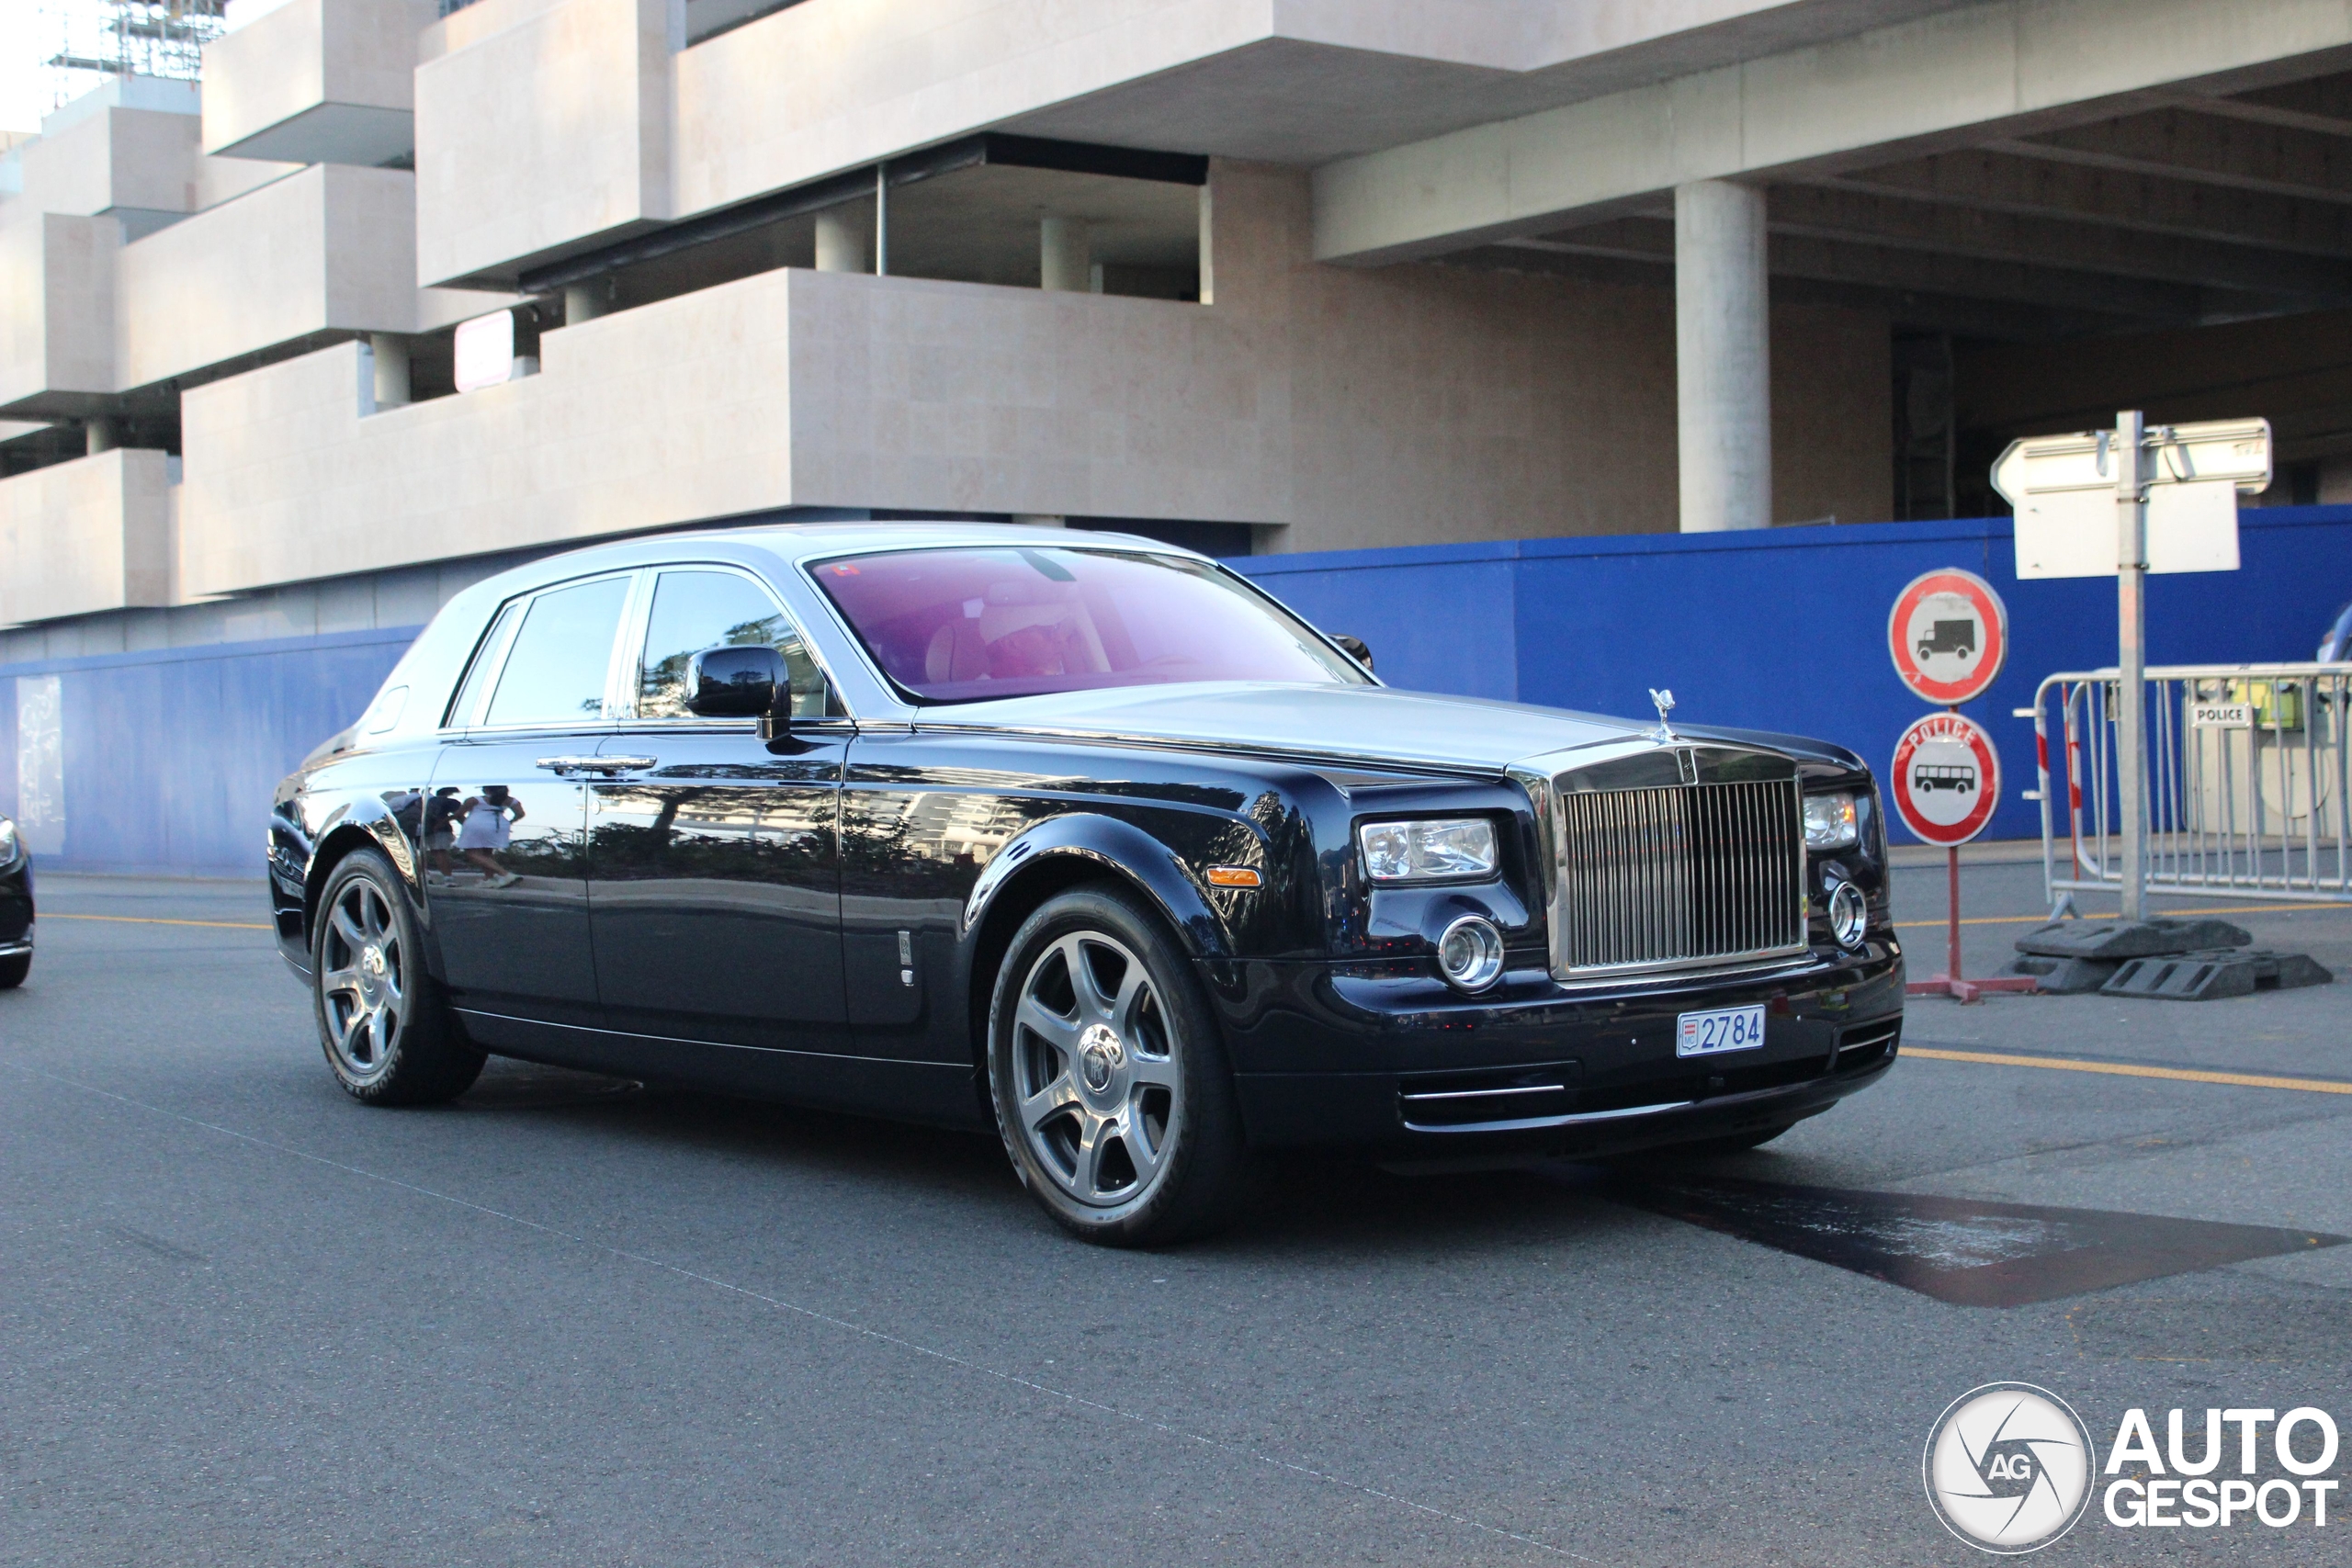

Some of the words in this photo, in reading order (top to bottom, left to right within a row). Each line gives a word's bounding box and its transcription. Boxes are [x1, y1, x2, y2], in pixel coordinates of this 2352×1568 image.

[2198, 708, 2243, 721] POLICE
[1908, 718, 1978, 750] POLICE
[1684, 1035, 1695, 1044] MC
[1702, 1012, 1759, 1049] 2784
